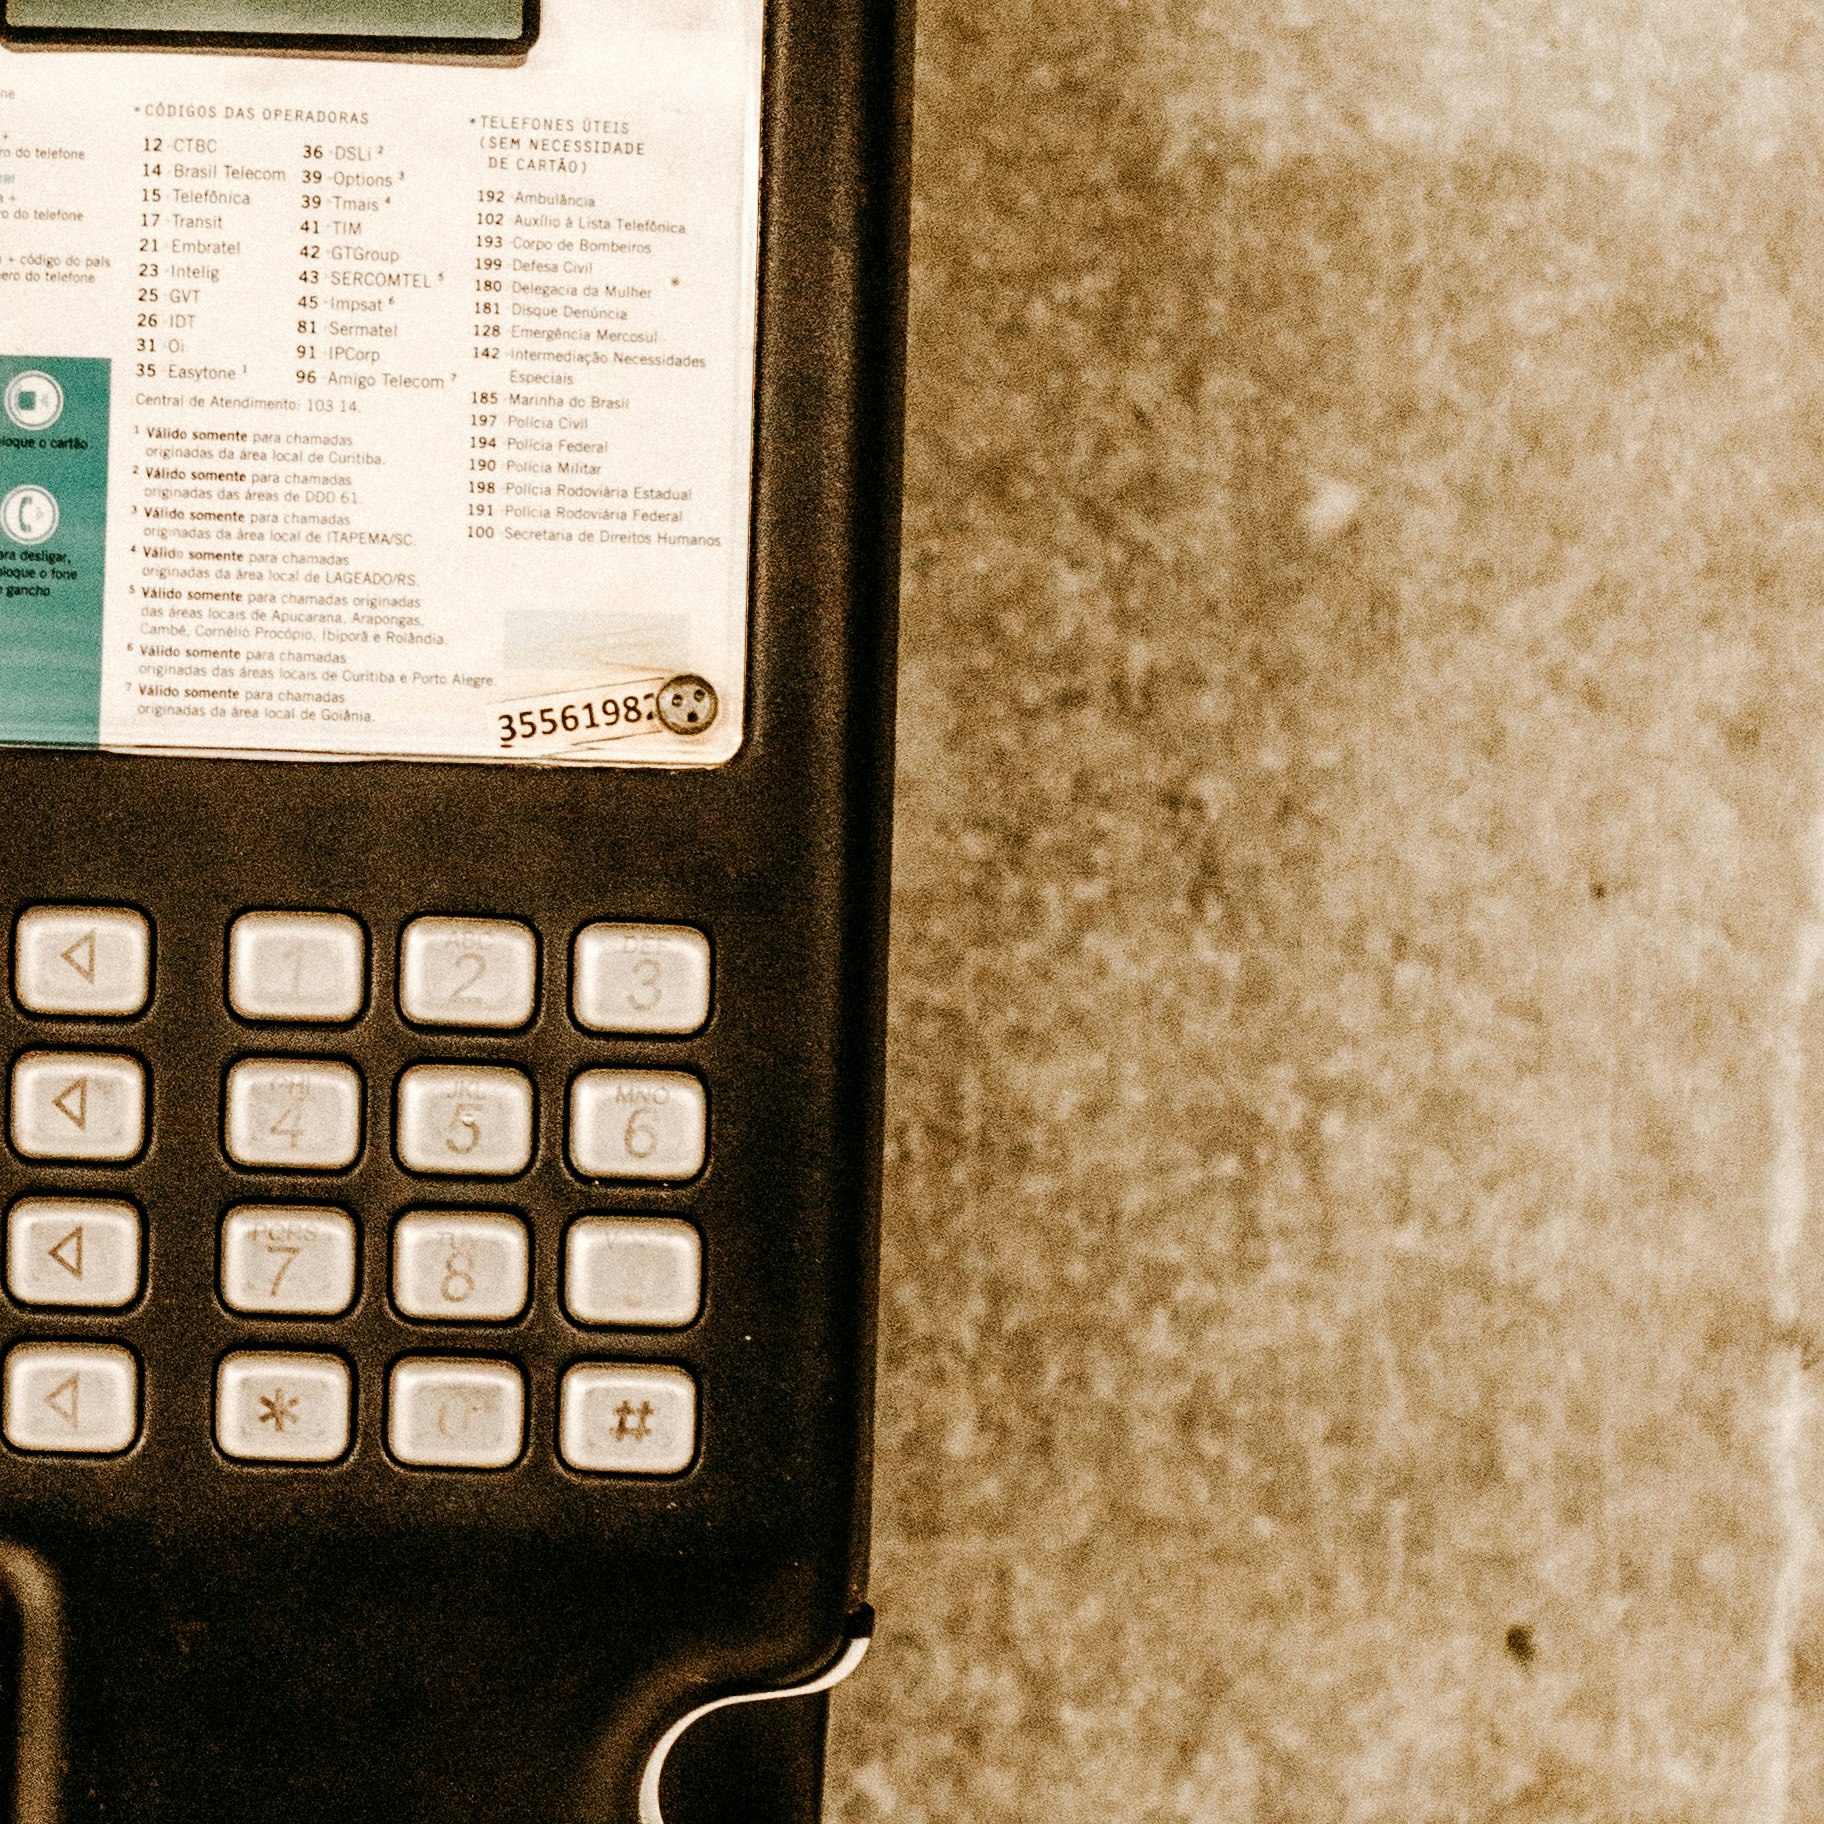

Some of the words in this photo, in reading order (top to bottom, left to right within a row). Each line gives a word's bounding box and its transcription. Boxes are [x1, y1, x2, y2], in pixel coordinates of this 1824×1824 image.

[145, 102, 217, 119] CÓDIGOS
[224, 106, 255, 120] DAS
[262, 108, 369, 125] OPERADORAS
[480, 114, 574, 132] TELEFONES
[583, 118, 629, 135] ÚTEIS
[144, 136, 163, 153] 12
[303, 144, 324, 160] 36
[335, 145, 371, 162] DSLi
[480, 136, 521, 149] (SEM
[529, 138, 645, 156] NECESSIDADE
[143, 162, 162, 177] 14
[174, 164, 217, 179] Brasil
[224, 164, 286, 180] Telecom
[488, 156, 507, 170] DE
[516, 157, 587, 174] CARTÃO)
[302, 169, 323, 184] 39
[333, 171, 393, 188] Options
[142, 187, 162, 203] 15
[174, 188, 251, 205] Telefônica
[301, 194, 322, 210] 39
[334, 195, 379, 212] Tmais
[478, 189, 505, 204] 192
[515, 191, 596, 208] Ambulância
[141, 212, 161, 228] 17
[173, 213, 222, 229] Transit
[299, 219, 319, 235] 41
[333, 220, 362, 235] TIM
[477, 212, 504, 226] 102
[515, 214, 560, 229] Auxílio
[566, 216, 572, 228] à
[579, 217, 611, 231] Lista
[617, 218, 686, 235] Telefônica
[139, 237, 158, 253] 21
[172, 239, 240, 255] Embratel
[476, 235, 503, 249] 193
[513, 237, 552, 252] Corpo
[557, 238, 573, 251] de
[580, 239, 652, 254] Bombeiros
[299, 245, 320, 260] 42
[331, 246, 400, 264] GTGroup
[139, 262, 159, 278] 23
[172, 266, 220, 283] Intelig
[476, 257, 503, 271] 199
[513, 259, 558, 273] Defesa
[563, 261, 592, 273] Civil
[298, 269, 319, 285] 43
[331, 271, 431, 289] SERCOMTEL
[138, 287, 159, 303] 25
[169, 289, 200, 303] GVT
[475, 279, 502, 293] 180
[512, 281, 578, 297] Delegacia
[583, 286, 599, 297] da
[605, 285, 652, 299] Mulher
[297, 295, 319, 310] 45
[331, 298, 382, 312] Impsat
[475, 301, 500, 315] 181
[513, 303, 558, 317] Disque
[563, 305, 628, 321] Denúncia
[137, 312, 158, 328] 26
[170, 314, 195, 328] IDT
[296, 319, 316, 335] 81
[330, 321, 397, 337] Sermatel
[474, 324, 501, 338] 128
[512, 326, 590, 342] Emergência
[597, 329, 658, 344] Mercosul
[137, 337, 156, 353] 31
[168, 338, 184, 353] Oi
[296, 344, 316, 360] 91
[329, 346, 380, 364] IPCorp
[473, 346, 500, 360] 142
[511, 350, 608, 366] Intermediação
[613, 352, 706, 368] Necessidades
[136, 362, 157, 378] 35
[168, 364, 236, 381] Easytone
[295, 369, 317, 384] 96
[328, 371, 376, 390] Amigo
[383, 372, 445, 389] Telecom
[510, 370, 573, 385] Especiais
[135, 393, 184, 407] Central
[189, 395, 205, 407] de
[308, 399, 333, 412] 103
[472, 391, 498, 405] 185
[509, 393, 564, 407] Marinha
[569, 397, 585, 408] do
[591, 395, 629, 410] Brasil
[471, 414, 497, 427] 197
[508, 415, 553, 429] Polícia
[559, 417, 587, 429] Civil
[146, 427, 187, 440] Válido
[192, 430, 248, 442] somente
[253, 433, 281, 444] para
[286, 433, 353, 446] chamadas
[471, 436, 497, 449] 194
[507, 437, 553, 451] Polícia
[558, 439, 608, 453] Federal
[470, 458, 496, 472] 190
[506, 460, 552, 473] Polícia
[557, 462, 601, 475] Militar
[469, 480, 496, 494] 198
[505, 482, 552, 496] Polícia
[557, 484, 628, 499] Rodoviária
[633, 486, 692, 501] Estadual
[468, 503, 494, 517] 191
[505, 505, 551, 519] Polícia
[556, 506, 627, 521] Rodoviária
[633, 509, 682, 523] Federal
[468, 526, 495, 540] 100
[505, 527, 573, 542] Secretaria
[578, 531, 594, 542] de
[600, 530, 651, 544] Direitos
[657, 533, 721, 547] Humanos
[449, 951, 487, 1005] 2
[627, 958, 662, 1012] 3
[271, 1096, 304, 1151] 4
[445, 1102, 482, 1155] 5
[624, 1106, 658, 1159] 6
[267, 1245, 301, 1297] 7
[441, 1252, 474, 1304] 8
